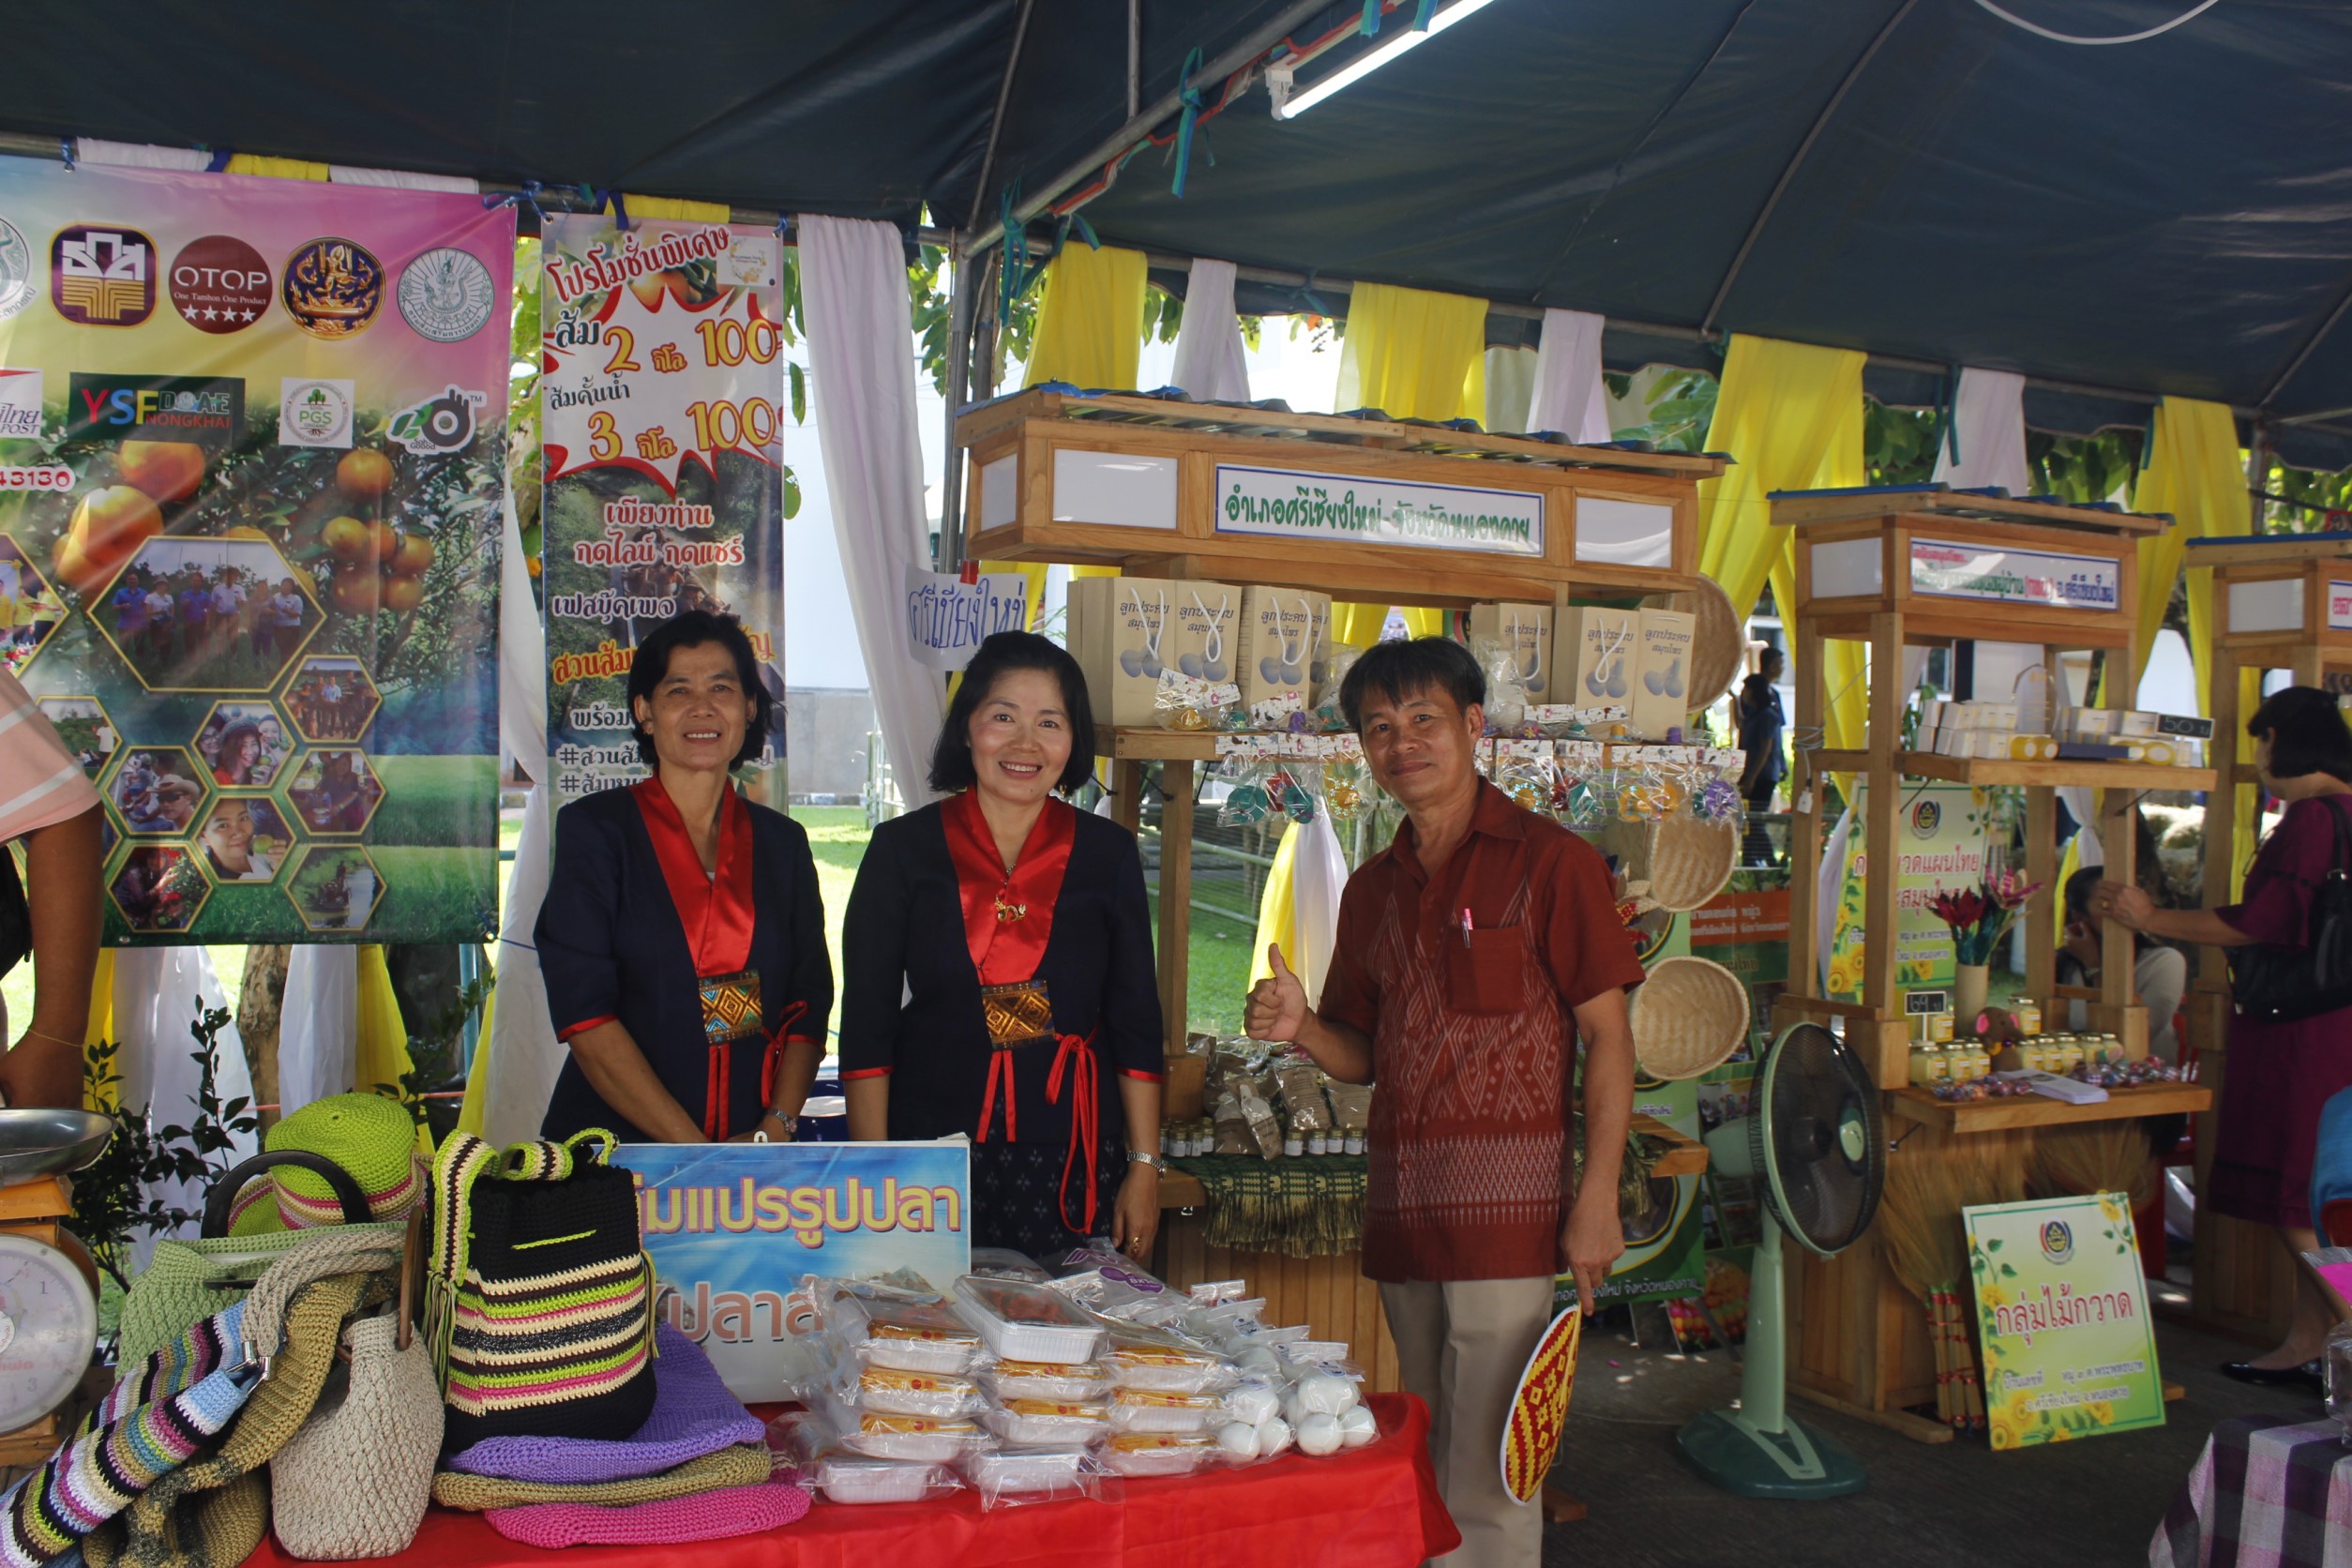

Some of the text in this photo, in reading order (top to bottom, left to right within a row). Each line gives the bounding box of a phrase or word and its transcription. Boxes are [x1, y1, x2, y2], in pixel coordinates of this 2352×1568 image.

[174, 266, 267, 291] OTOP
[546, 227, 730, 302] โปรโมชั่นพิเศษ
[173, 292, 267, 305] One Tambon One Product
[556, 309, 777, 373] ส้ม 2 กิโล 100
[550, 371, 630, 410] ส้มคั้นน้ำ
[81, 388, 158, 425] YSF
[145, 414, 231, 429] NONGKHAI
[299, 411, 332, 424] PGS
[588, 397, 776, 460] 3 กิโล 100
[606, 497, 713, 528] เพียงท่าน
[666, 536, 744, 565] กดแชร์
[554, 592, 675, 623] เฟสบุ๊คเพจ
[1645, 629, 1691, 642] ลูกประคบ
[1995, 1283, 2133, 1346] กลุ่มไม้กวาด
